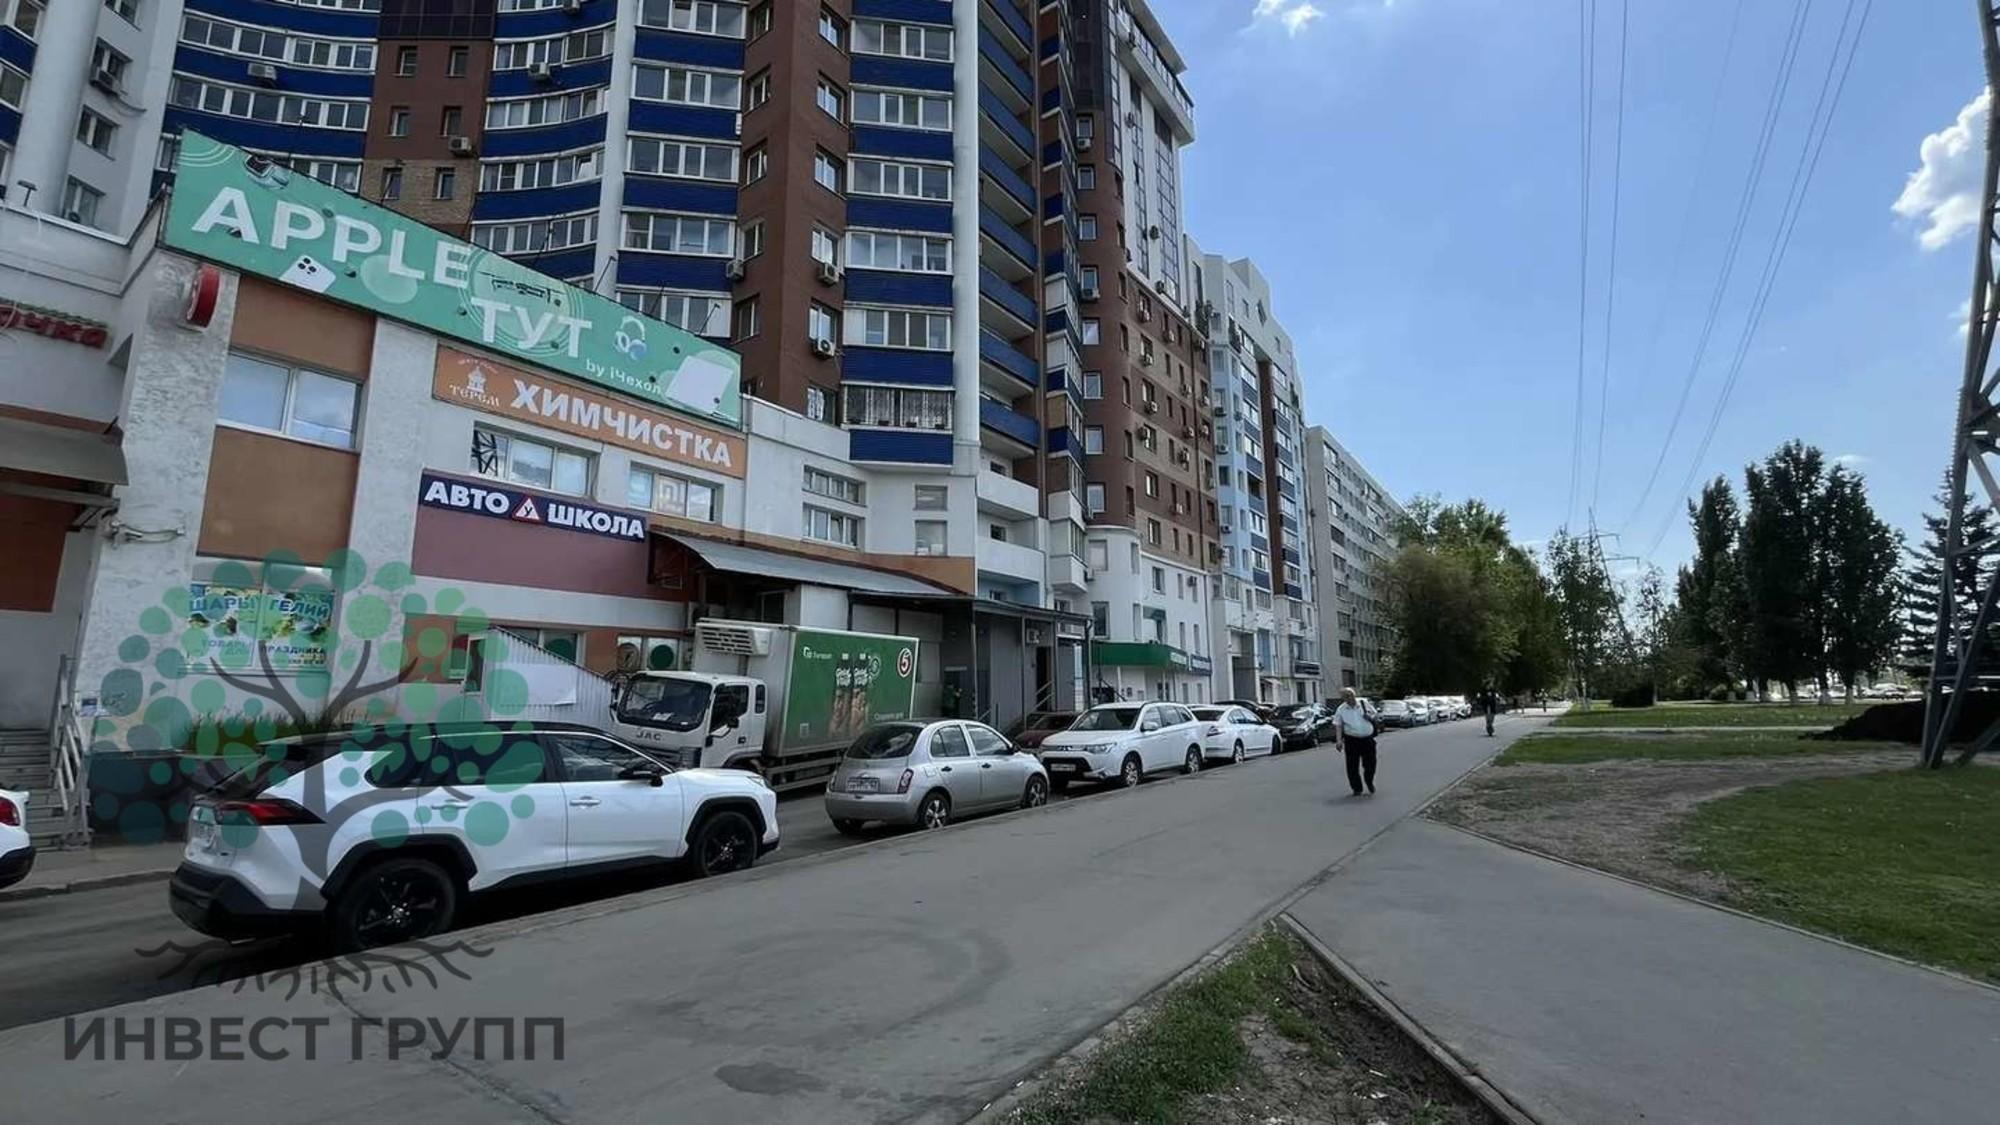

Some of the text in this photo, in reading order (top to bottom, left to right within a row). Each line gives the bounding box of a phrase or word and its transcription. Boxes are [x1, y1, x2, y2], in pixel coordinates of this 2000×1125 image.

[191, 186, 470, 288] APPLE
[470, 296, 593, 358] ТУТ
[585, 358, 606, 377] by
[510, 378, 732, 467] ХИМЧИСТКА
[423, 480, 510, 514] АВТО
[547, 503, 645, 539] ШКОЛА
[269, 599, 329, 618] ГЕЛИЙ
[636, 731, 662, 741] JAC
